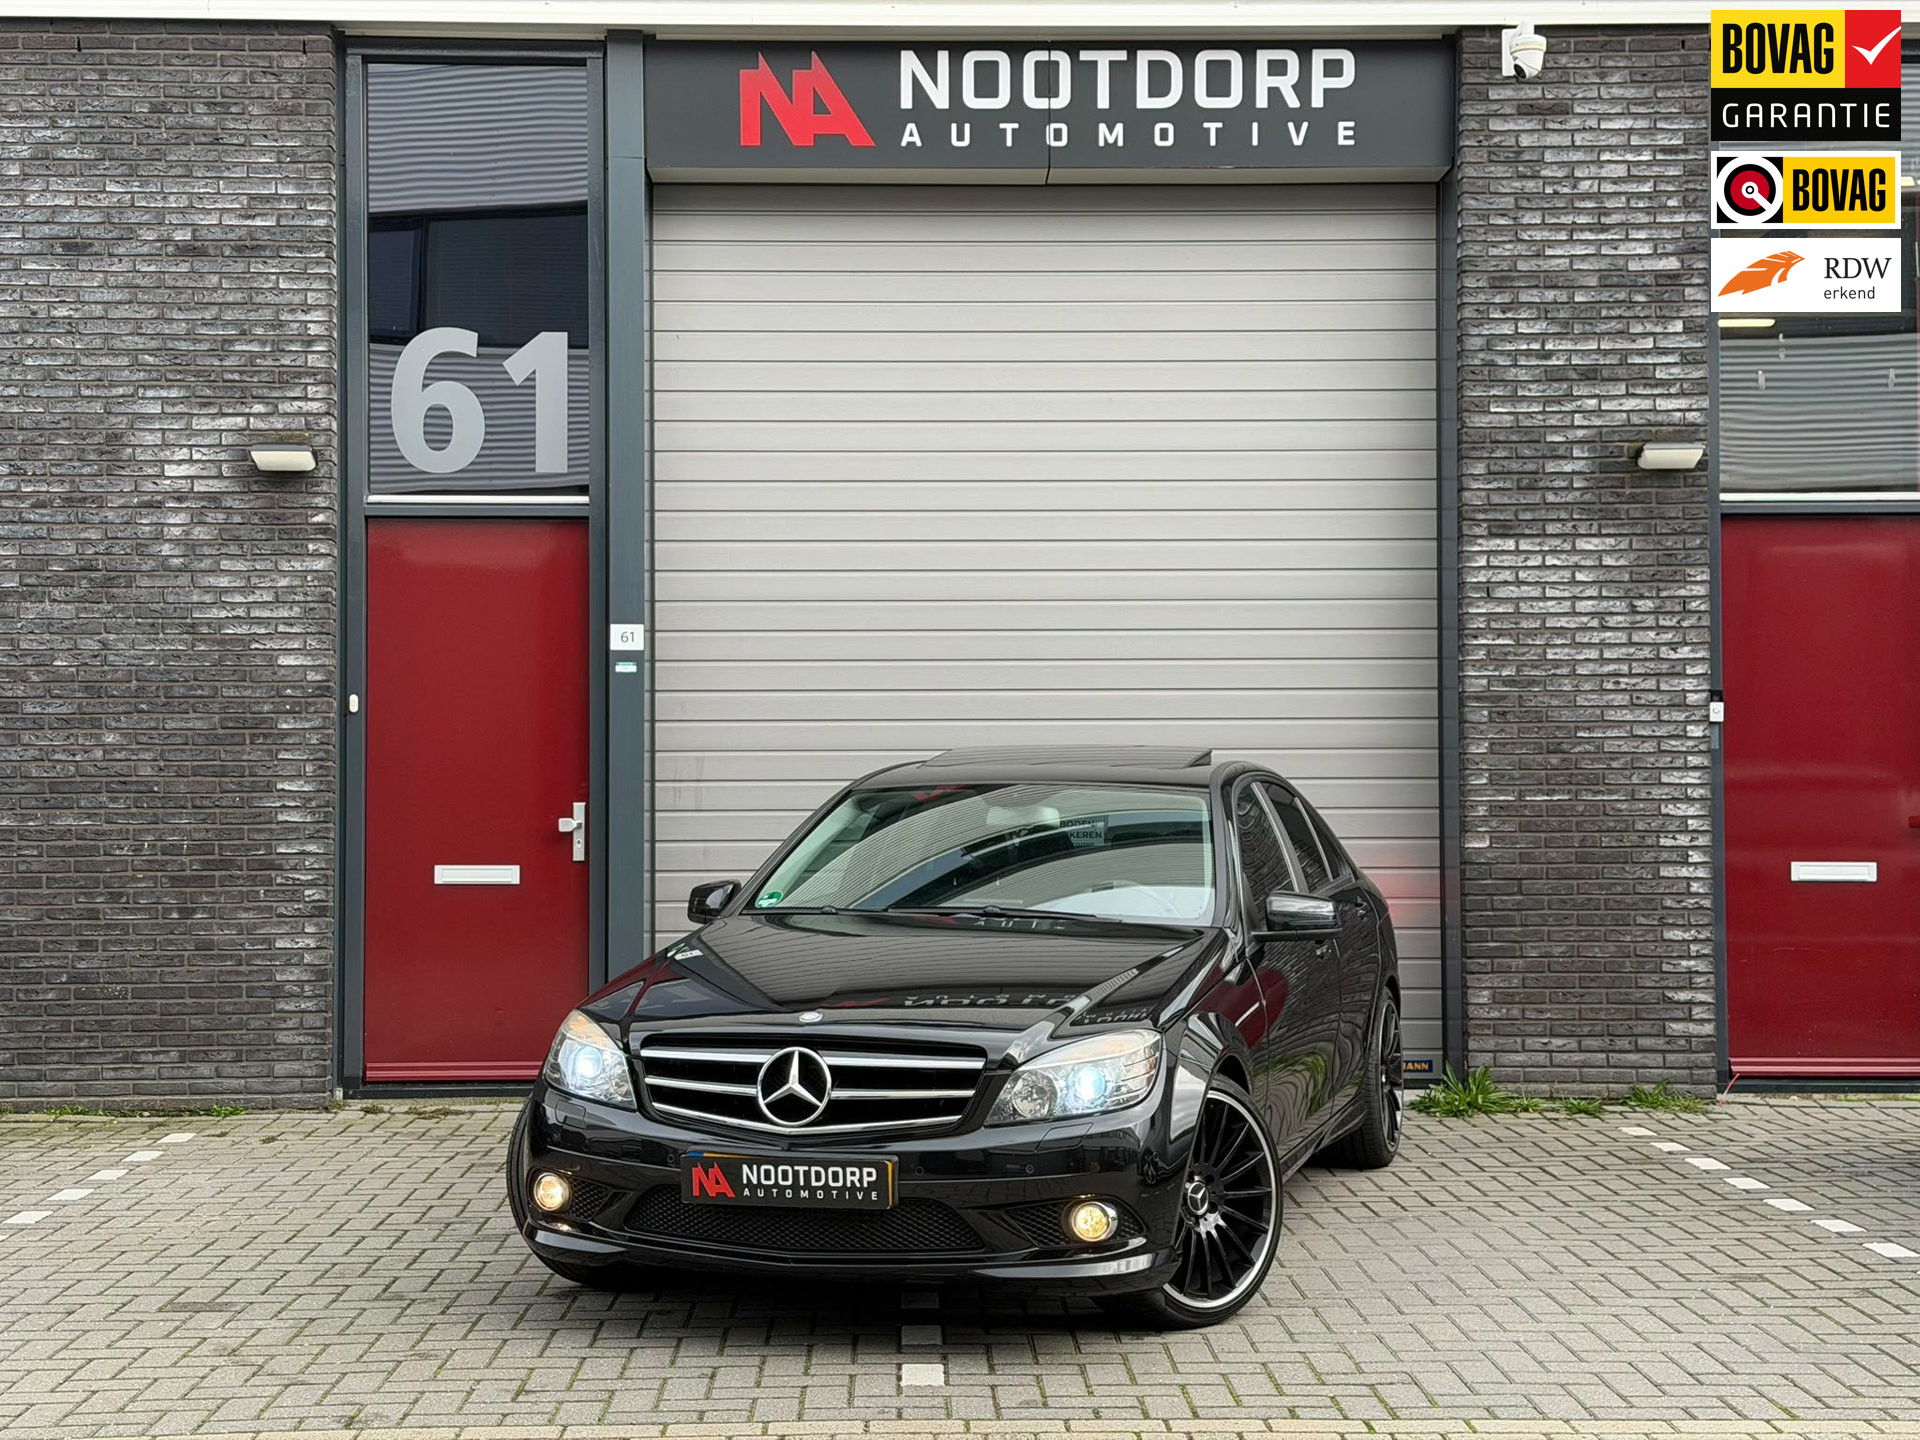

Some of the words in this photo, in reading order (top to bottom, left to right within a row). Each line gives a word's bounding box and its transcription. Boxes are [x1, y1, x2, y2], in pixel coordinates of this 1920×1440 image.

[900, 50, 1355, 109] NOOTDORP
[900, 121, 1356, 147] AUTOMOTIVE
[391, 327, 568, 473] 61
[620, 631, 635, 643] 61
[742, 1164, 877, 1188] NOOTDORP
[743, 1187, 878, 1200] AUTOMOTIVE
